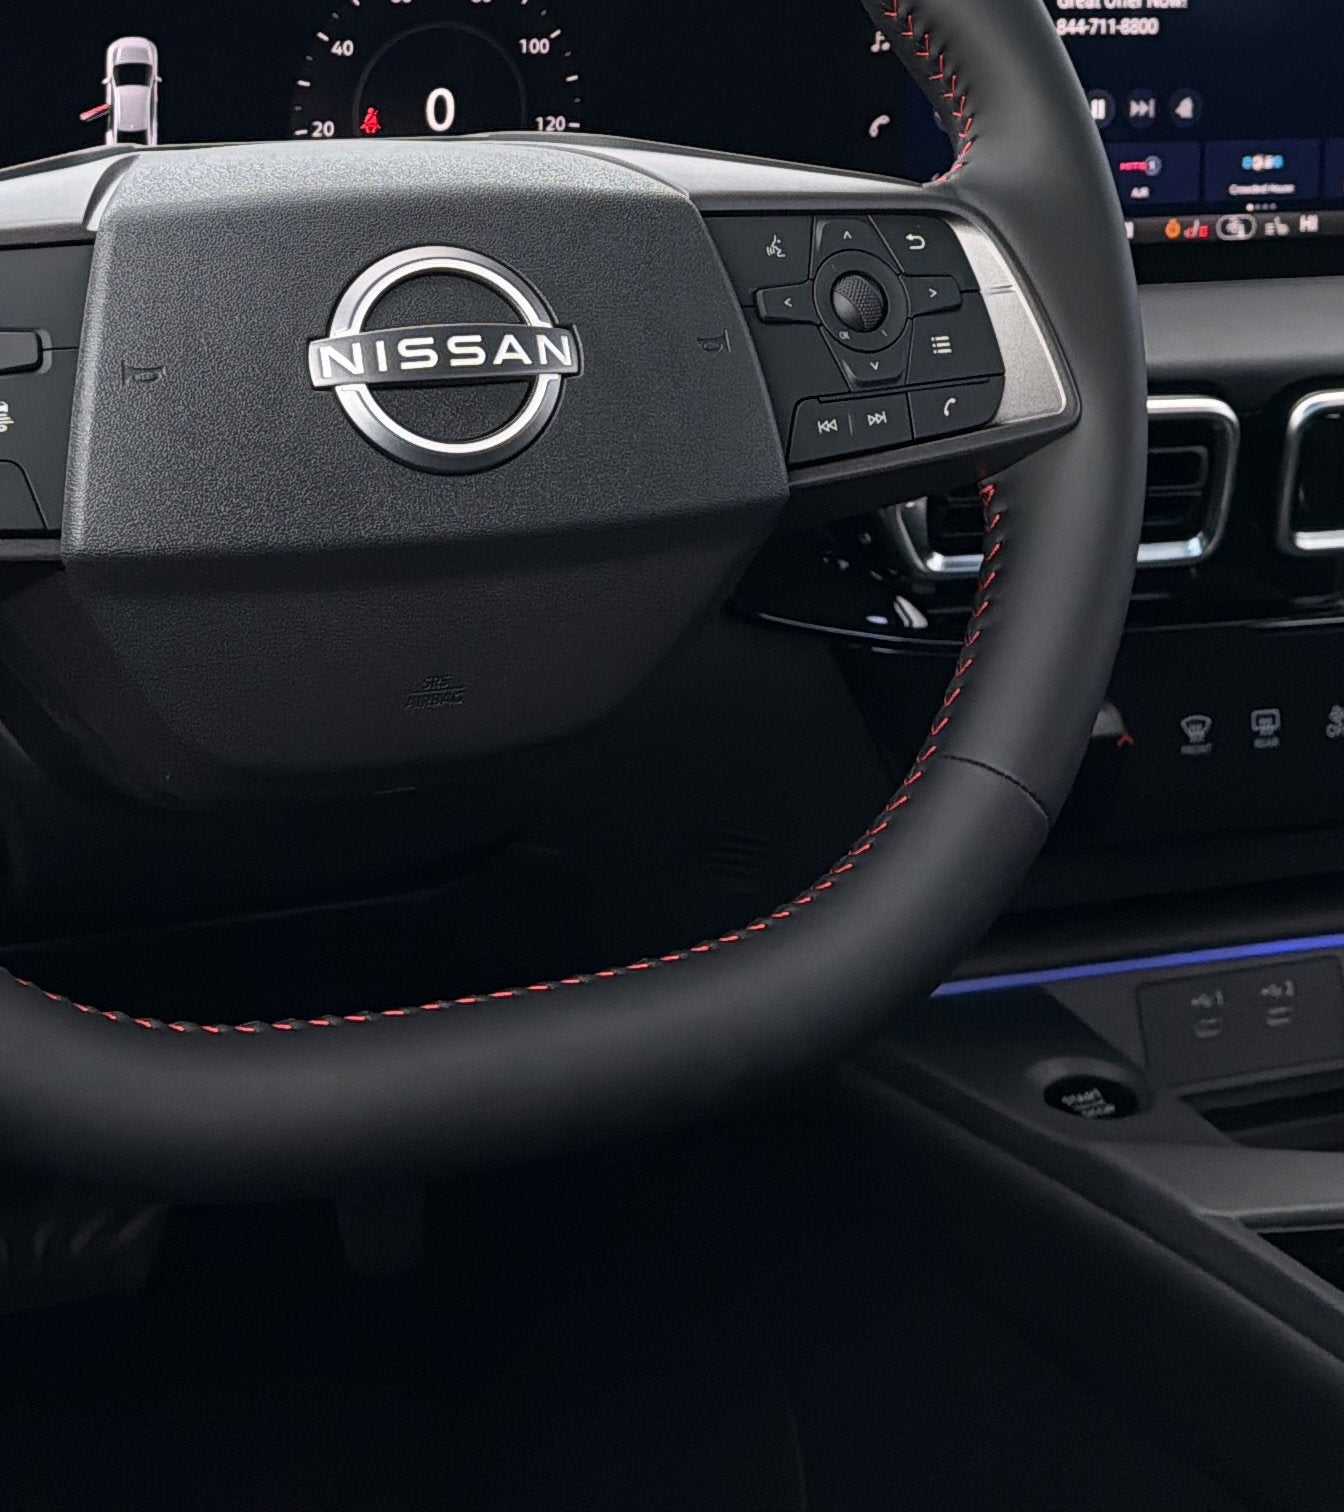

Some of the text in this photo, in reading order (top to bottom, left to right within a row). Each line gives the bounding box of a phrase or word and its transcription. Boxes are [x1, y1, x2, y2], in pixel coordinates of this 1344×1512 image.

[330, 39, 355, 57] 40
[519, 38, 550, 55] 100
[424, 86, 456, 133] 0
[311, 120, 335, 138] 20
[536, 115, 566, 133] 120
[319, 334, 572, 379] NISSAN
